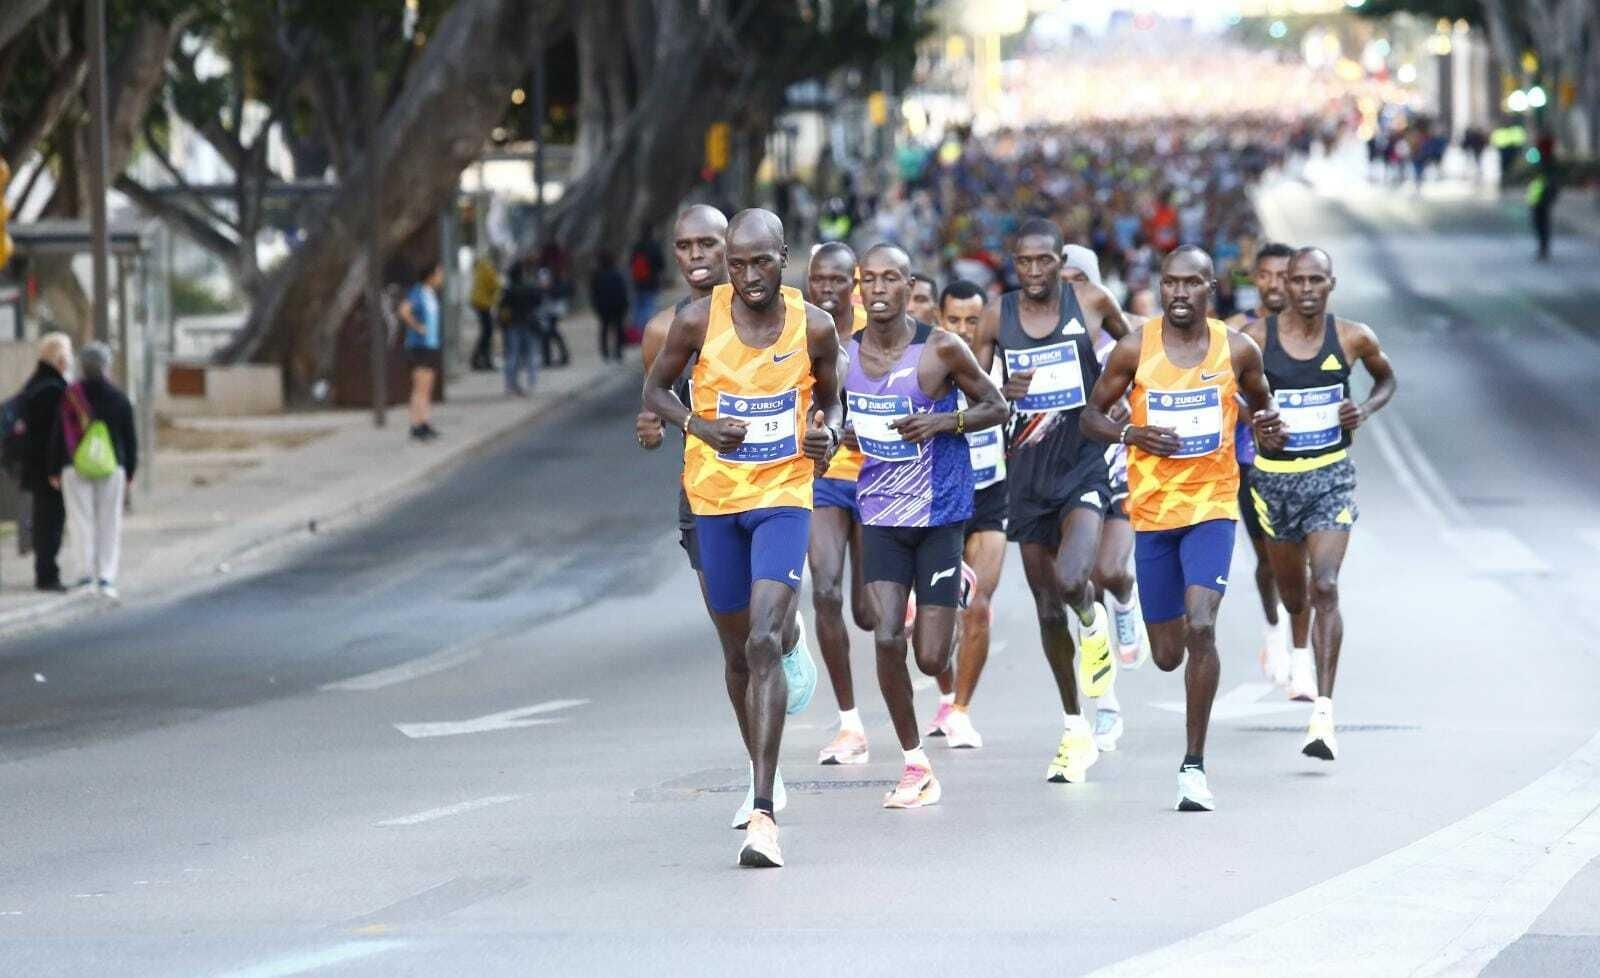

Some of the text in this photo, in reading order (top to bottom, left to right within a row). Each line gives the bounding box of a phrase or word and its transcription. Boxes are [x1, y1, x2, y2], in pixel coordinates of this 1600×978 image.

[1174, 394, 1206, 404] ZURICH
[750, 399, 784, 410] ZURICH
[868, 401, 896, 409] ZURICH
[764, 421, 779, 432] 13
